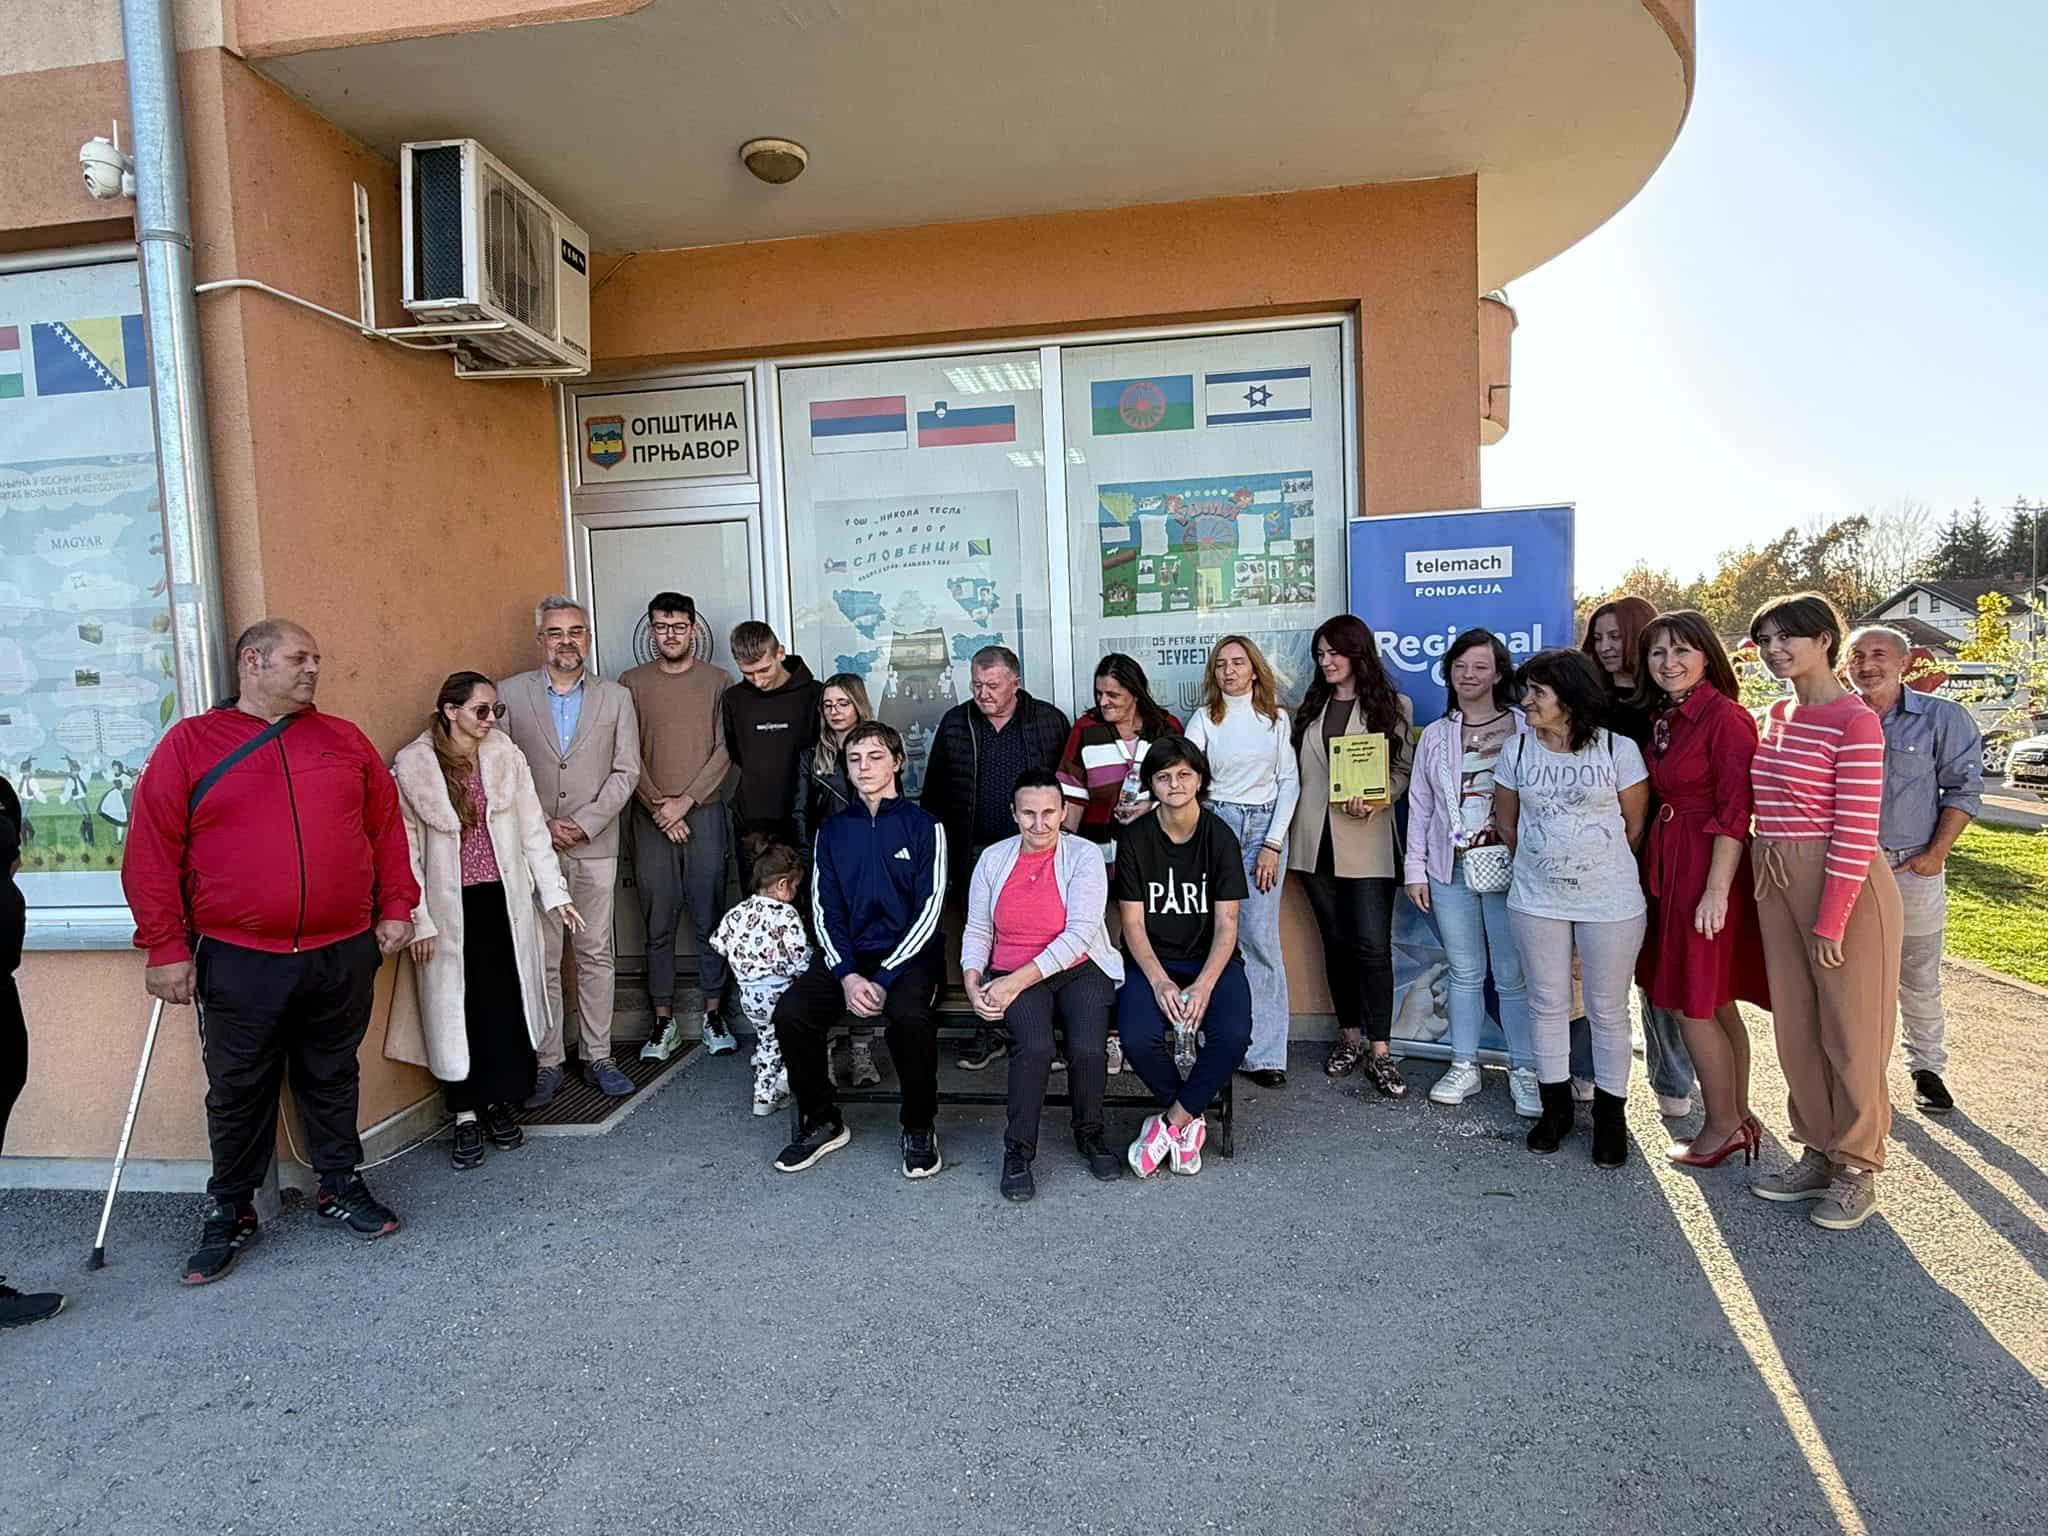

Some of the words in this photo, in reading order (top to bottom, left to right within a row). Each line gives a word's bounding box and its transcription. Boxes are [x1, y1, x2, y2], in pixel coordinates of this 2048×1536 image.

[632, 412, 738, 435] ОПШТИНА
[633, 440, 740, 463] ПРЊАВОР
[51, 535, 103, 550] MAGYAR
[853, 541, 961, 567] СЛОВЕНЦИ
[1416, 555, 1502, 574] telemach
[1415, 583, 1503, 598] FONDACIJA
[1374, 623, 1543, 673] Regial
